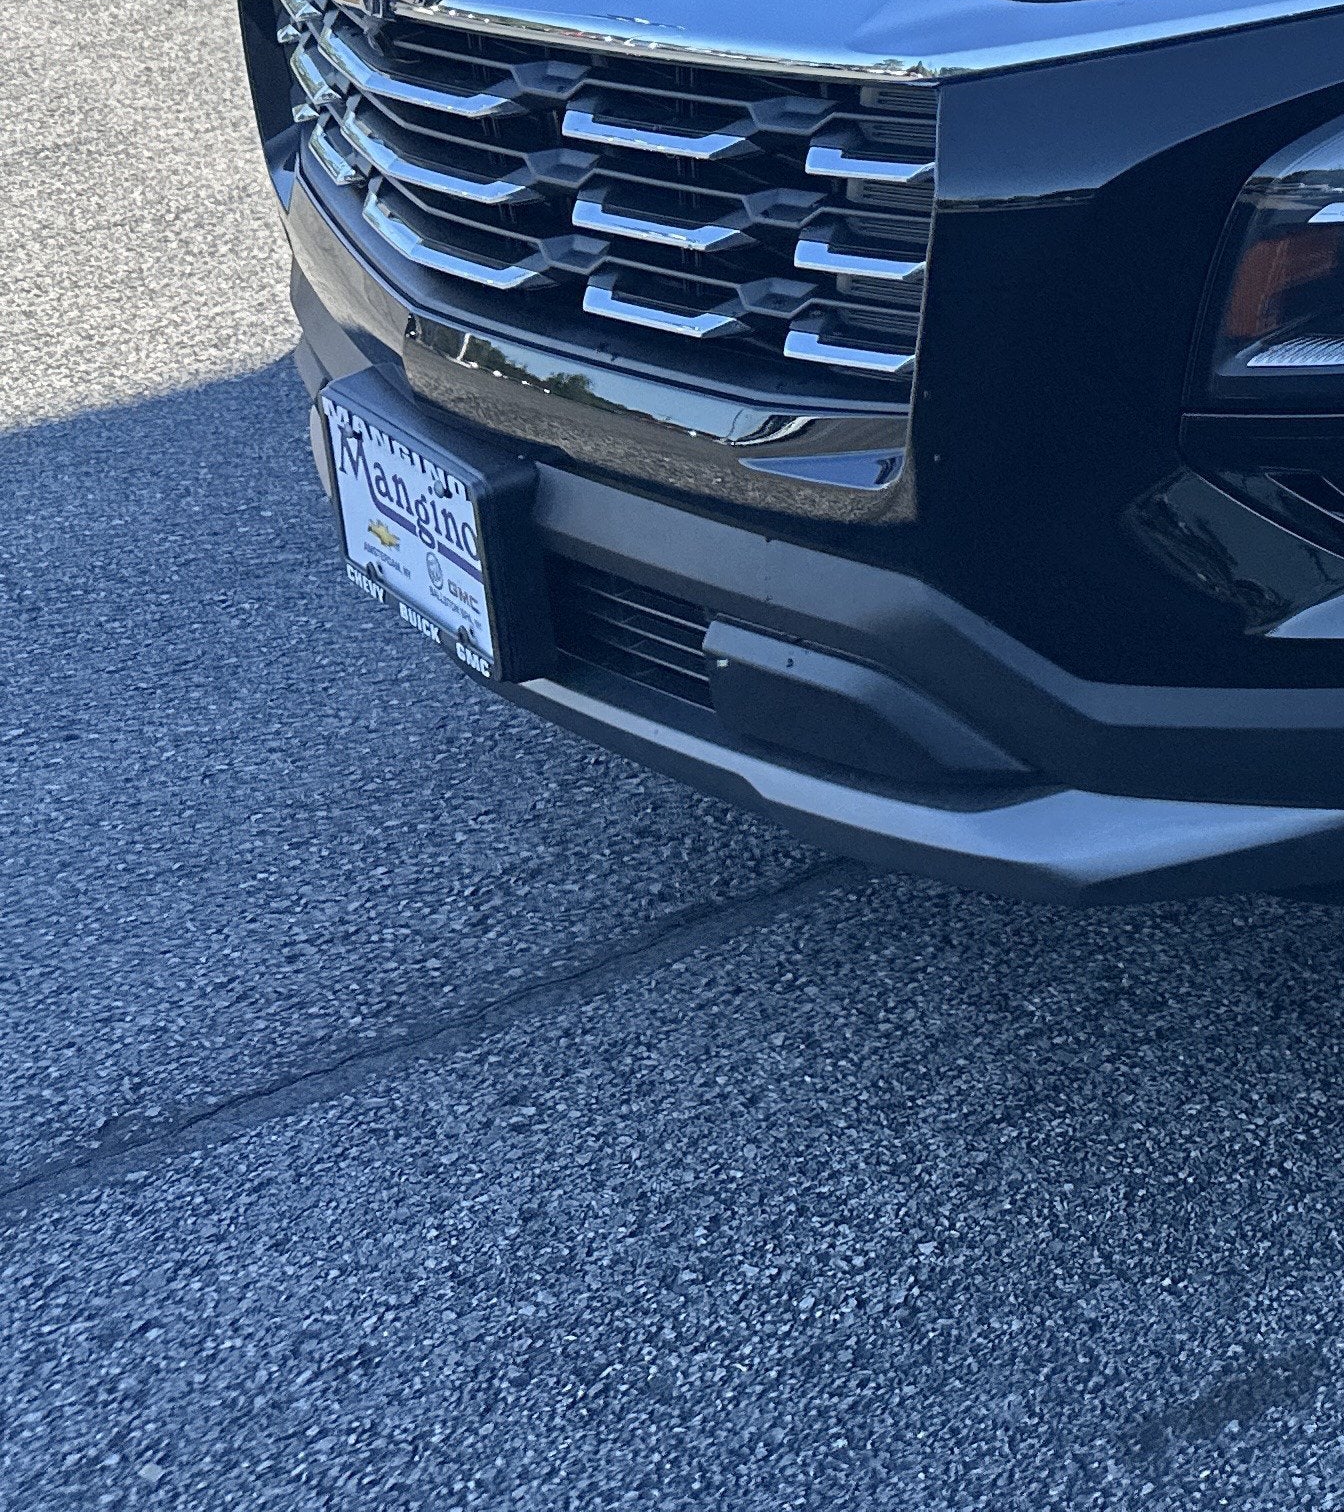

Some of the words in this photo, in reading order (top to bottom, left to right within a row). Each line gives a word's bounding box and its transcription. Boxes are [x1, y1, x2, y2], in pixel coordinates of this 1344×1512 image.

[337, 424, 481, 561] Mangino
[346, 563, 386, 604] CHEVY
[399, 602, 442, 644] BUICK
[455, 641, 491, 678] GMC
[447, 578, 481, 615] GMC
